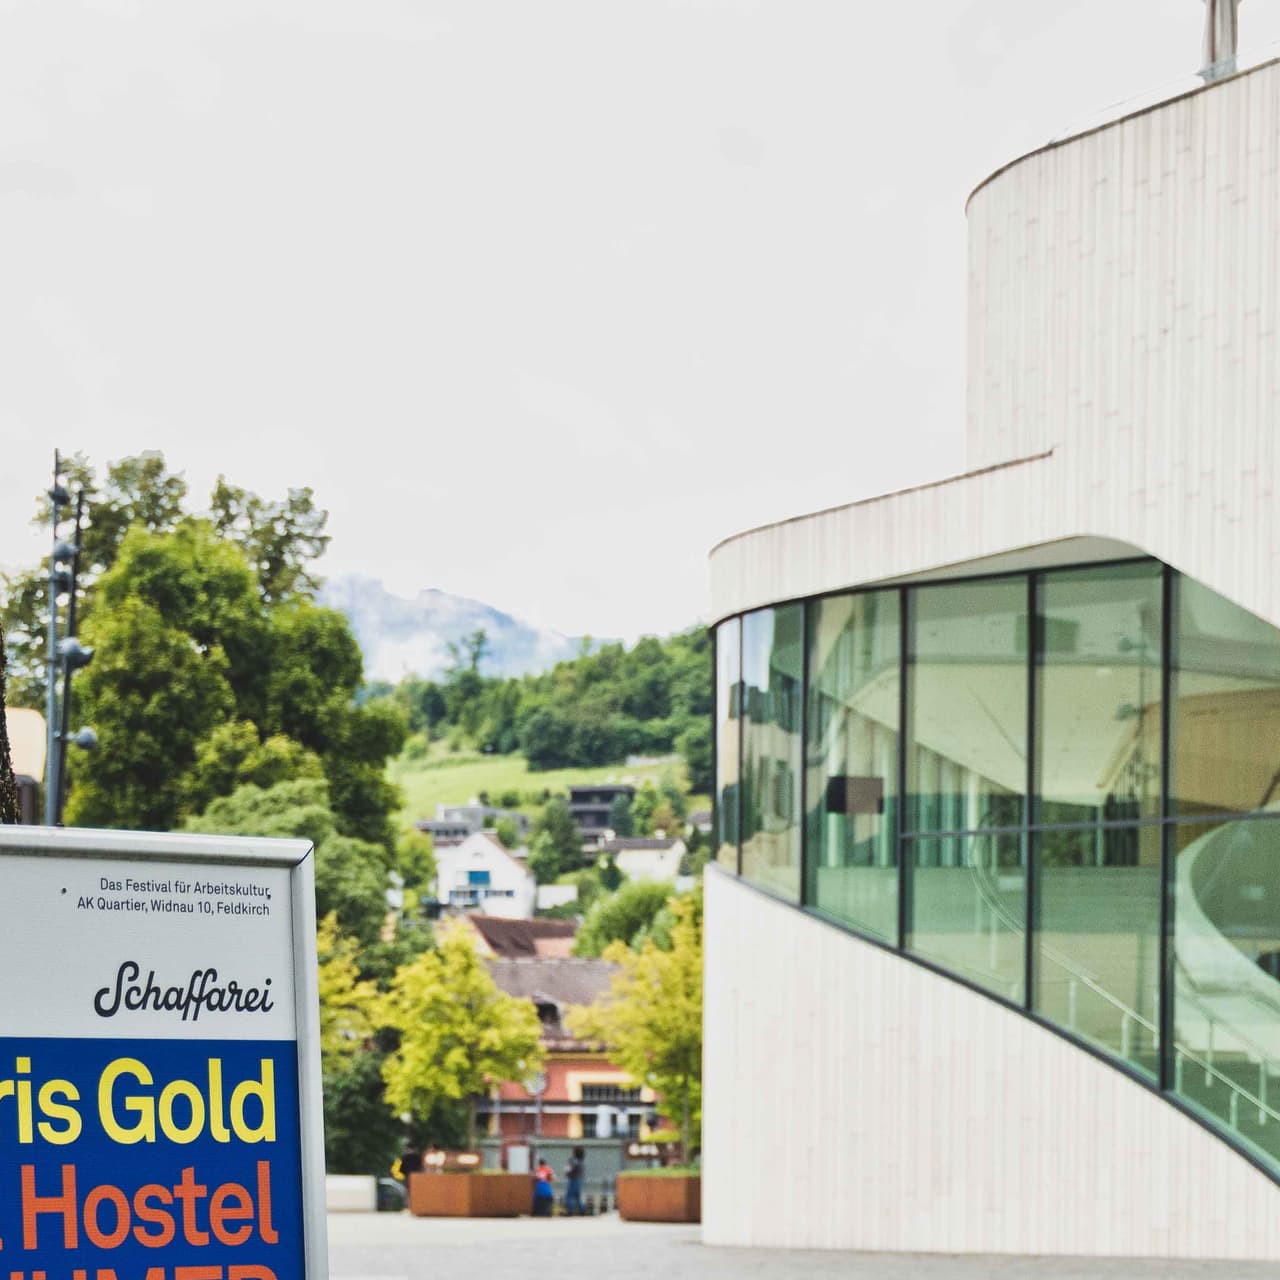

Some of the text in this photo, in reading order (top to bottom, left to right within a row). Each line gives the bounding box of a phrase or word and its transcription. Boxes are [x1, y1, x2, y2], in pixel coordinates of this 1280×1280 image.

[77, 897, 270, 916] AK Quartier, Widnau 10, Feldkirch
[100, 878, 122, 891] Das
[126, 879, 171, 893] Festival
[174, 880, 191, 894] für
[94, 960, 274, 1021] Schaffarei
[97, 1057, 276, 1144] Gold
[20, 1160, 279, 1249] Hostel
